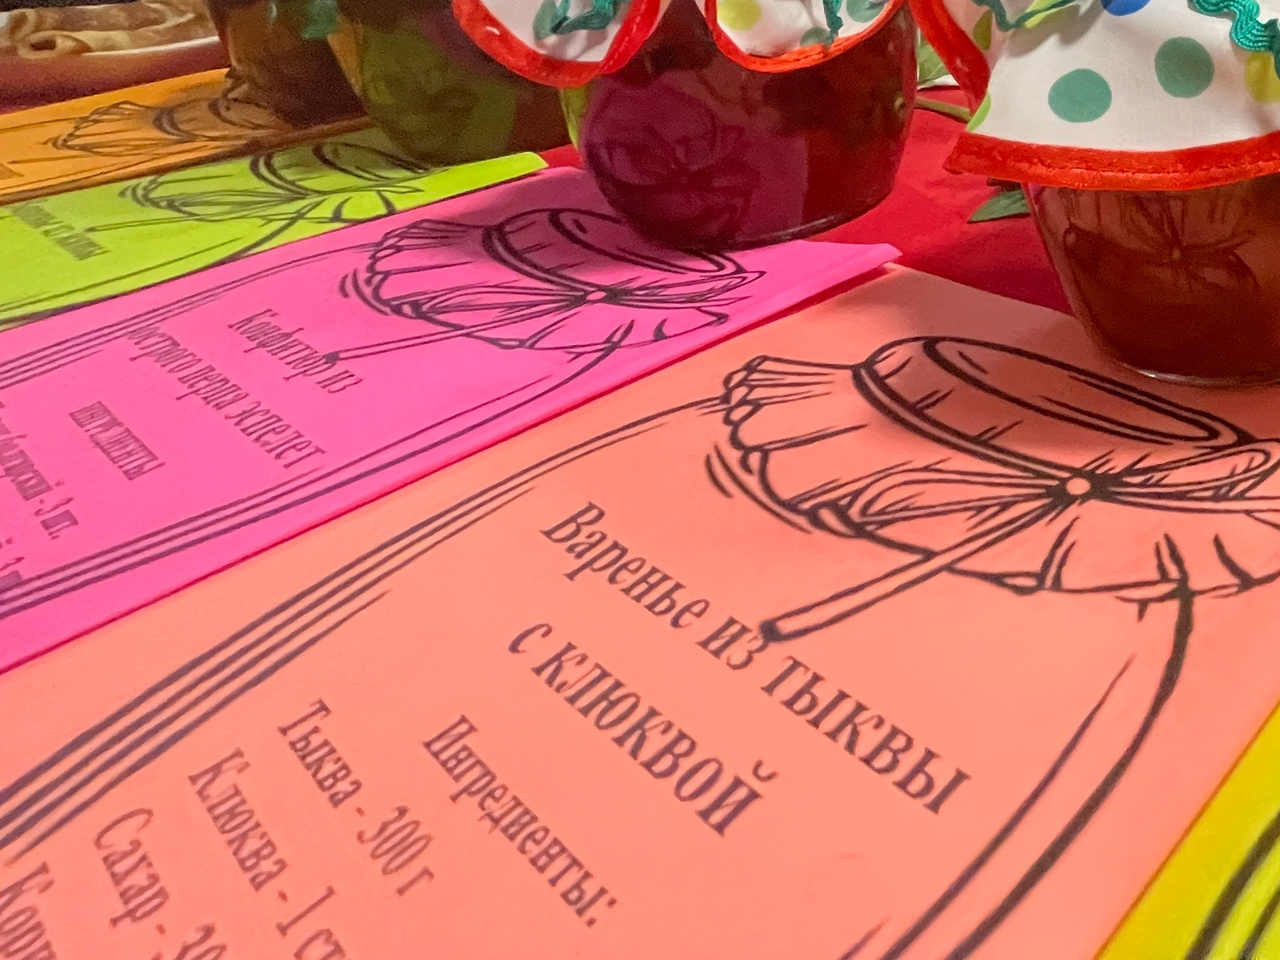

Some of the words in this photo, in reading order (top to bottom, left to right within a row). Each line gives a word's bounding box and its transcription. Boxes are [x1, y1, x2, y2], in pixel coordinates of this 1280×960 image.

[224, 400, 327, 469] эспелет
[227, 309, 338, 381] Конфитюр
[315, 369, 364, 393] из
[507, 622, 553, 655] с
[530, 641, 780, 838] клюквой
[540, 501, 711, 630] Варенье
[696, 615, 771, 671] из
[761, 655, 972, 815] тыквы
[94, 807, 171, 928] Сахар
[188, 746, 288, 892] Клюква
[276, 885, 336, 938] 1
[277, 698, 364, 808] Тыква
[356, 804, 436, 876] 300
[396, 866, 435, 897] г
[422, 713, 618, 928] Ингредиенты:
